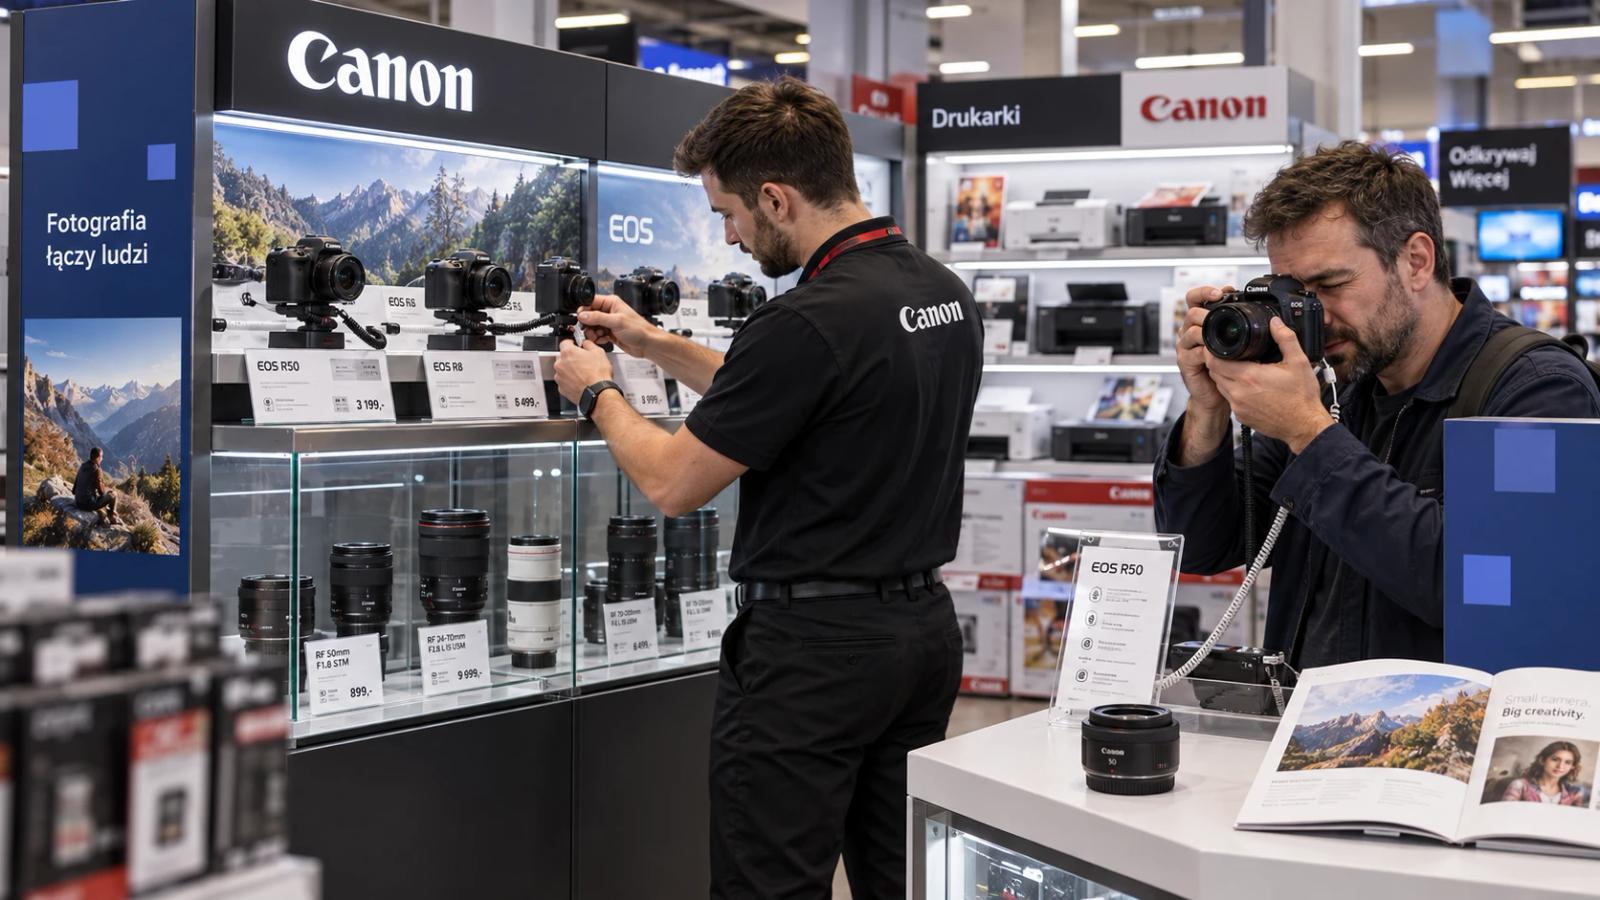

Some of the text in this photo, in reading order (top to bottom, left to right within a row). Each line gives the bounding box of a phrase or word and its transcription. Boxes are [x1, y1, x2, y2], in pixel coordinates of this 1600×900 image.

[288, 31, 473, 112] Canon
[1140, 95, 1268, 122] Canon
[932, 104, 1021, 129] Drukarki
[1449, 143, 1537, 167] Odkrywaj
[1449, 168, 1509, 191] Więcej
[47, 209, 147, 237] Fotografia
[609, 214, 654, 245] EOS
[46, 242, 148, 271] łączy ludzi
[899, 301, 964, 333] Canon
[257, 361, 300, 372] EOS R50
[433, 362, 463, 372] EOS R8
[356, 399, 385, 411] 3 199,-
[1091, 561, 1144, 576] EOS R50
[427, 635, 436, 644] RF
[316, 649, 350, 659] RF 50mm
[316, 658, 350, 670] F1.8 STM
[350, 686, 372, 698] 899,-
[1505, 694, 1538, 705] Small
[1502, 707, 1521, 718] Big
[1101, 747, 1125, 756] Canon
